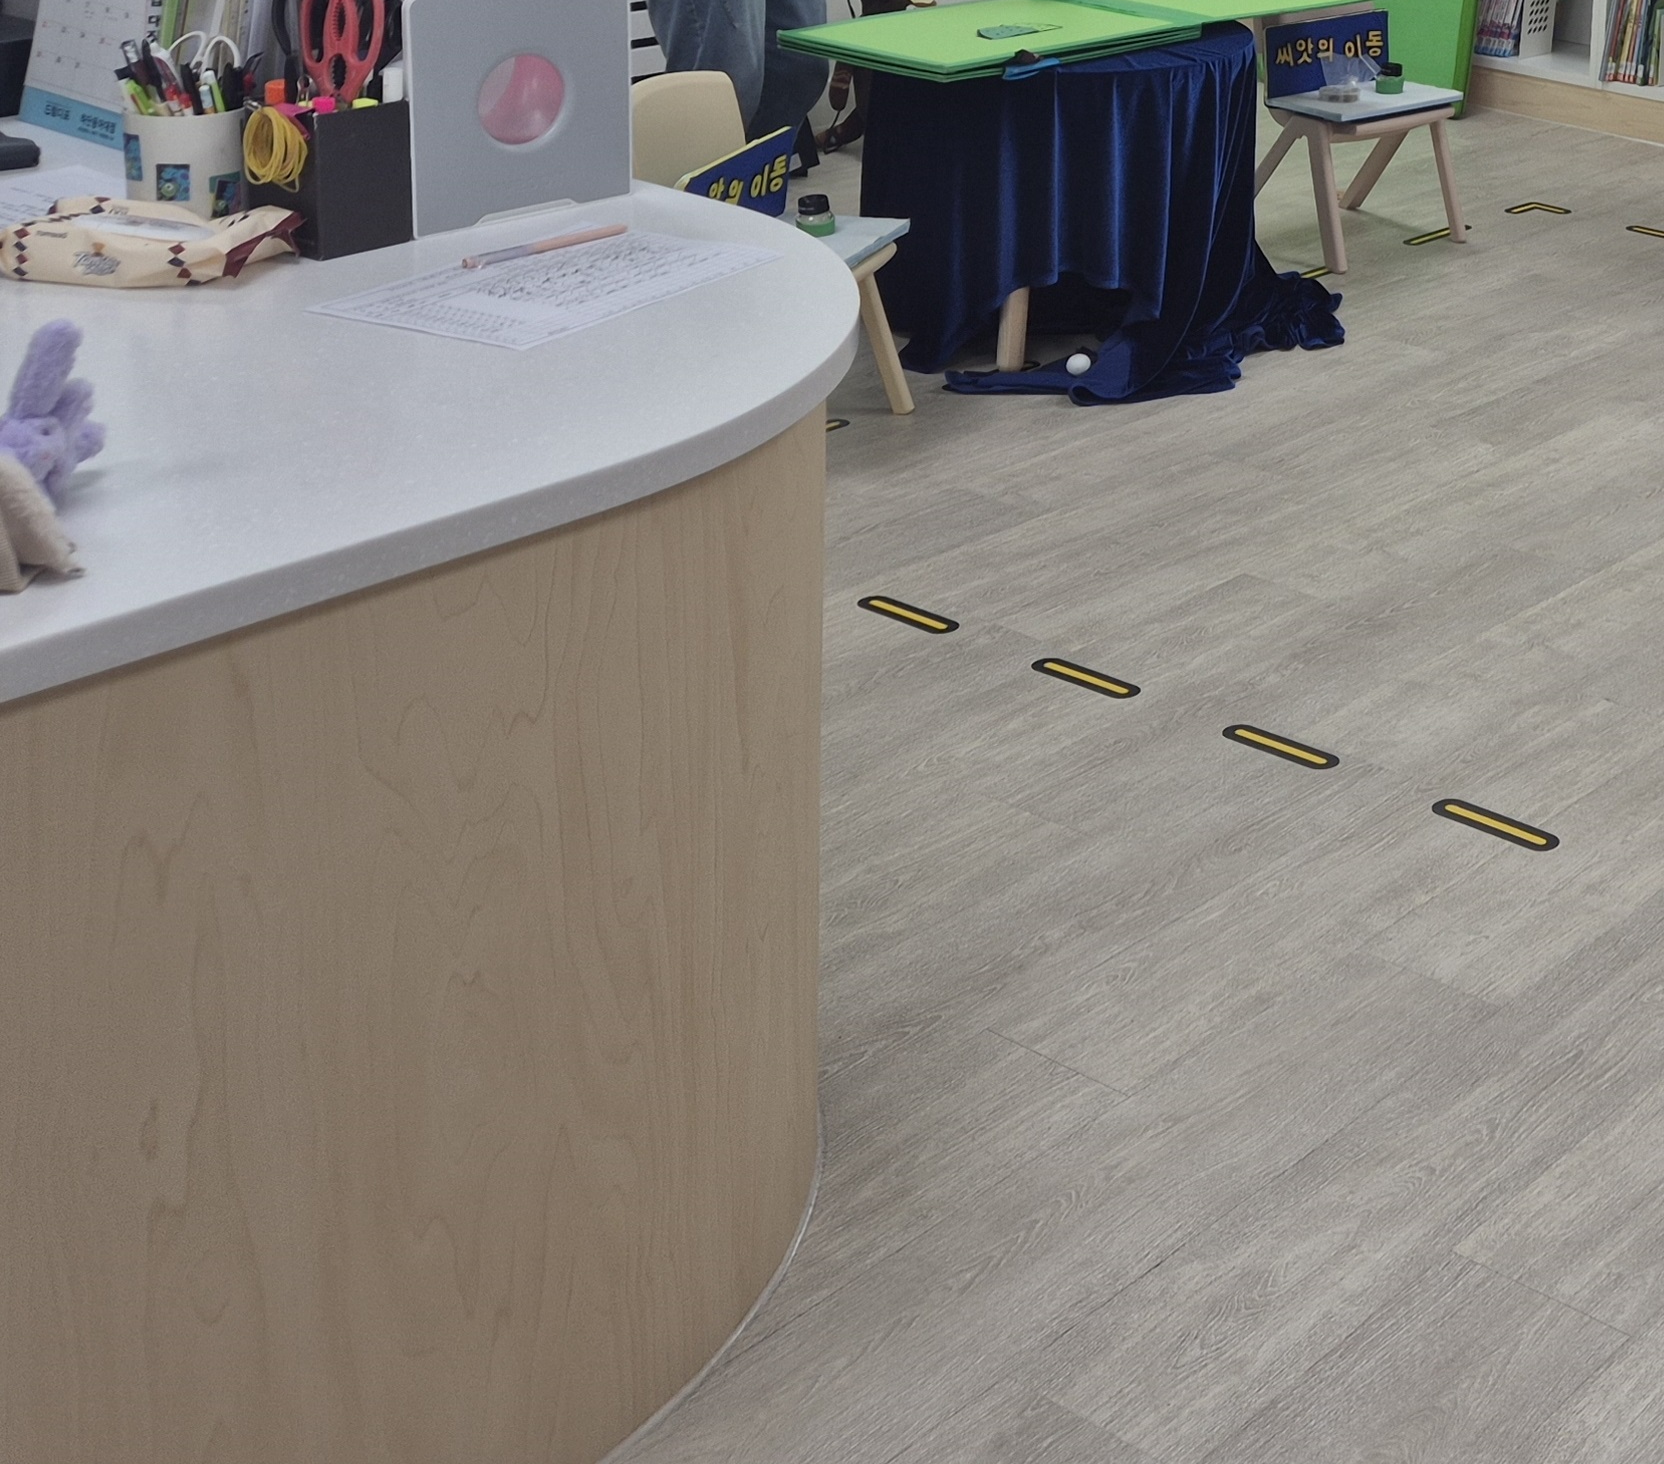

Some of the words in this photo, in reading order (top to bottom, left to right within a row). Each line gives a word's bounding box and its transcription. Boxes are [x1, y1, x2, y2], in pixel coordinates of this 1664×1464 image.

[1275, 37, 1335, 67] 씨앗의
[1344, 30, 1384, 57] 이동
[750, 154, 788, 198] 이동
